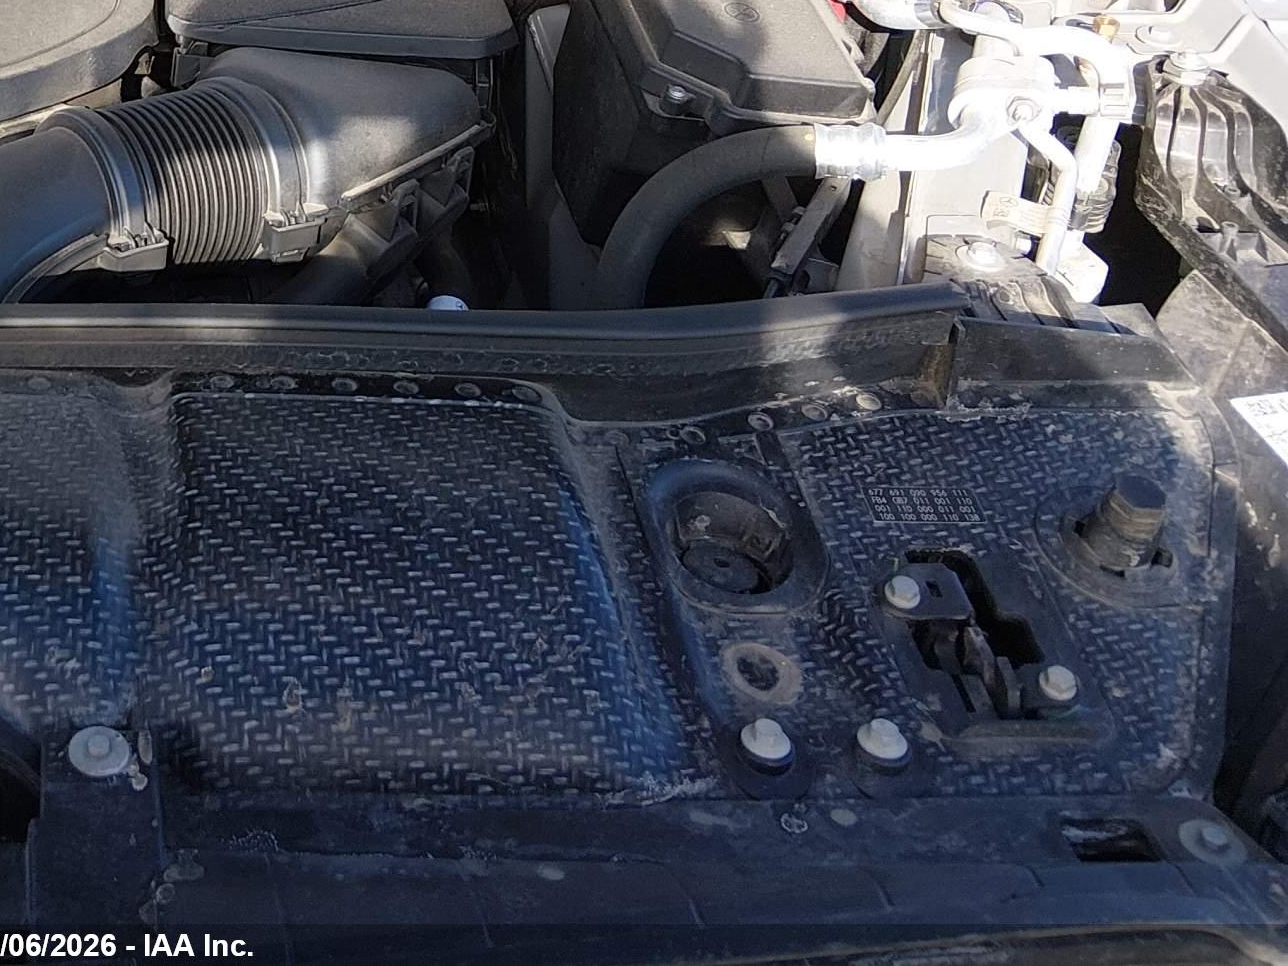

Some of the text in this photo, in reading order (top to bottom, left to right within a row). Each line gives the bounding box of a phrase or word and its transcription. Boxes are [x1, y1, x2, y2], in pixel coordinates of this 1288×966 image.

[875, 505, 976, 513] 001 110 000 011 001
